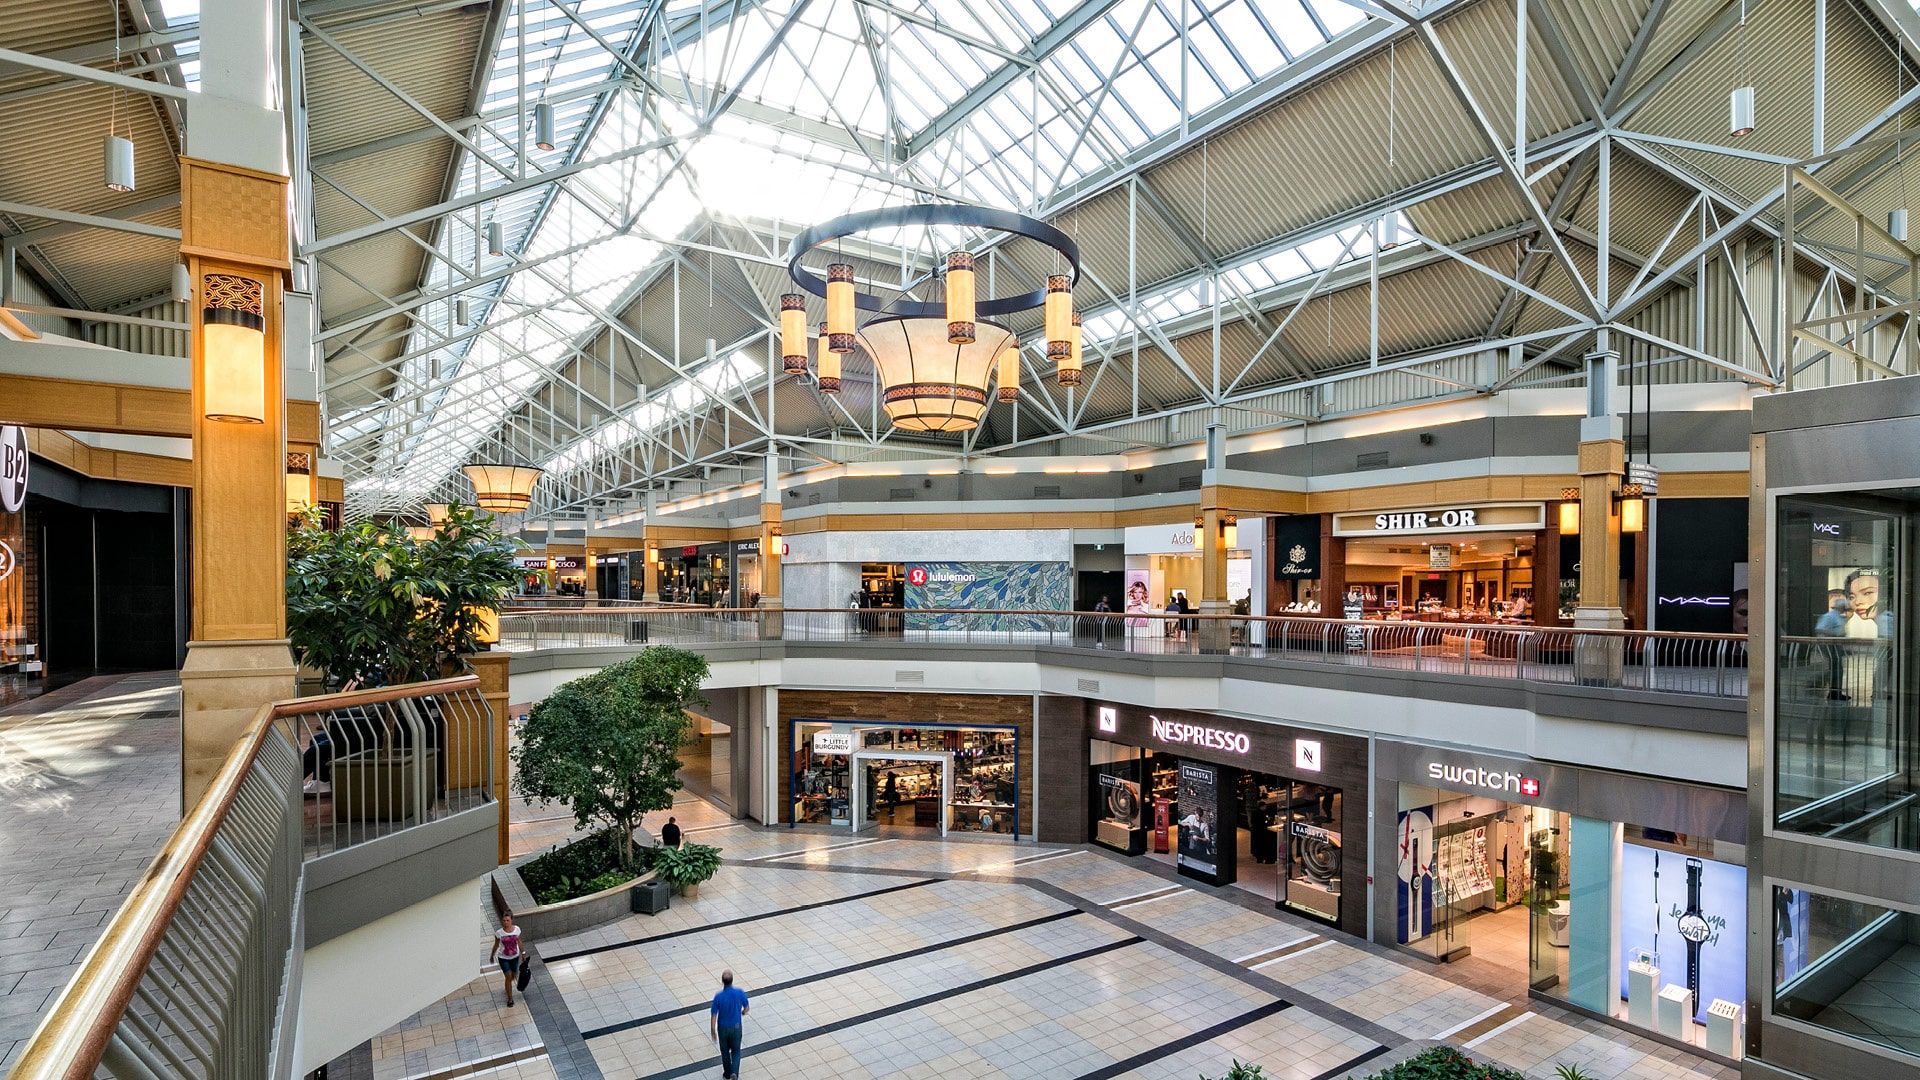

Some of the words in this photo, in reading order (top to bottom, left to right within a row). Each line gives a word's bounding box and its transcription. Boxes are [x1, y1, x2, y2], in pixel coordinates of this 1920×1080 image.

[3, 444, 25, 484] B2
[1375, 510, 1476, 530] SHIR-OR
[929, 572, 976, 582] lululemon
[1150, 715, 1250, 754] NESPRESSO
[1101, 777, 1121, 787] BARISTA
[1185, 769, 1209, 780] BARISTA
[1429, 763, 1521, 793] swatch
[1295, 825, 1324, 838] BARISTA
